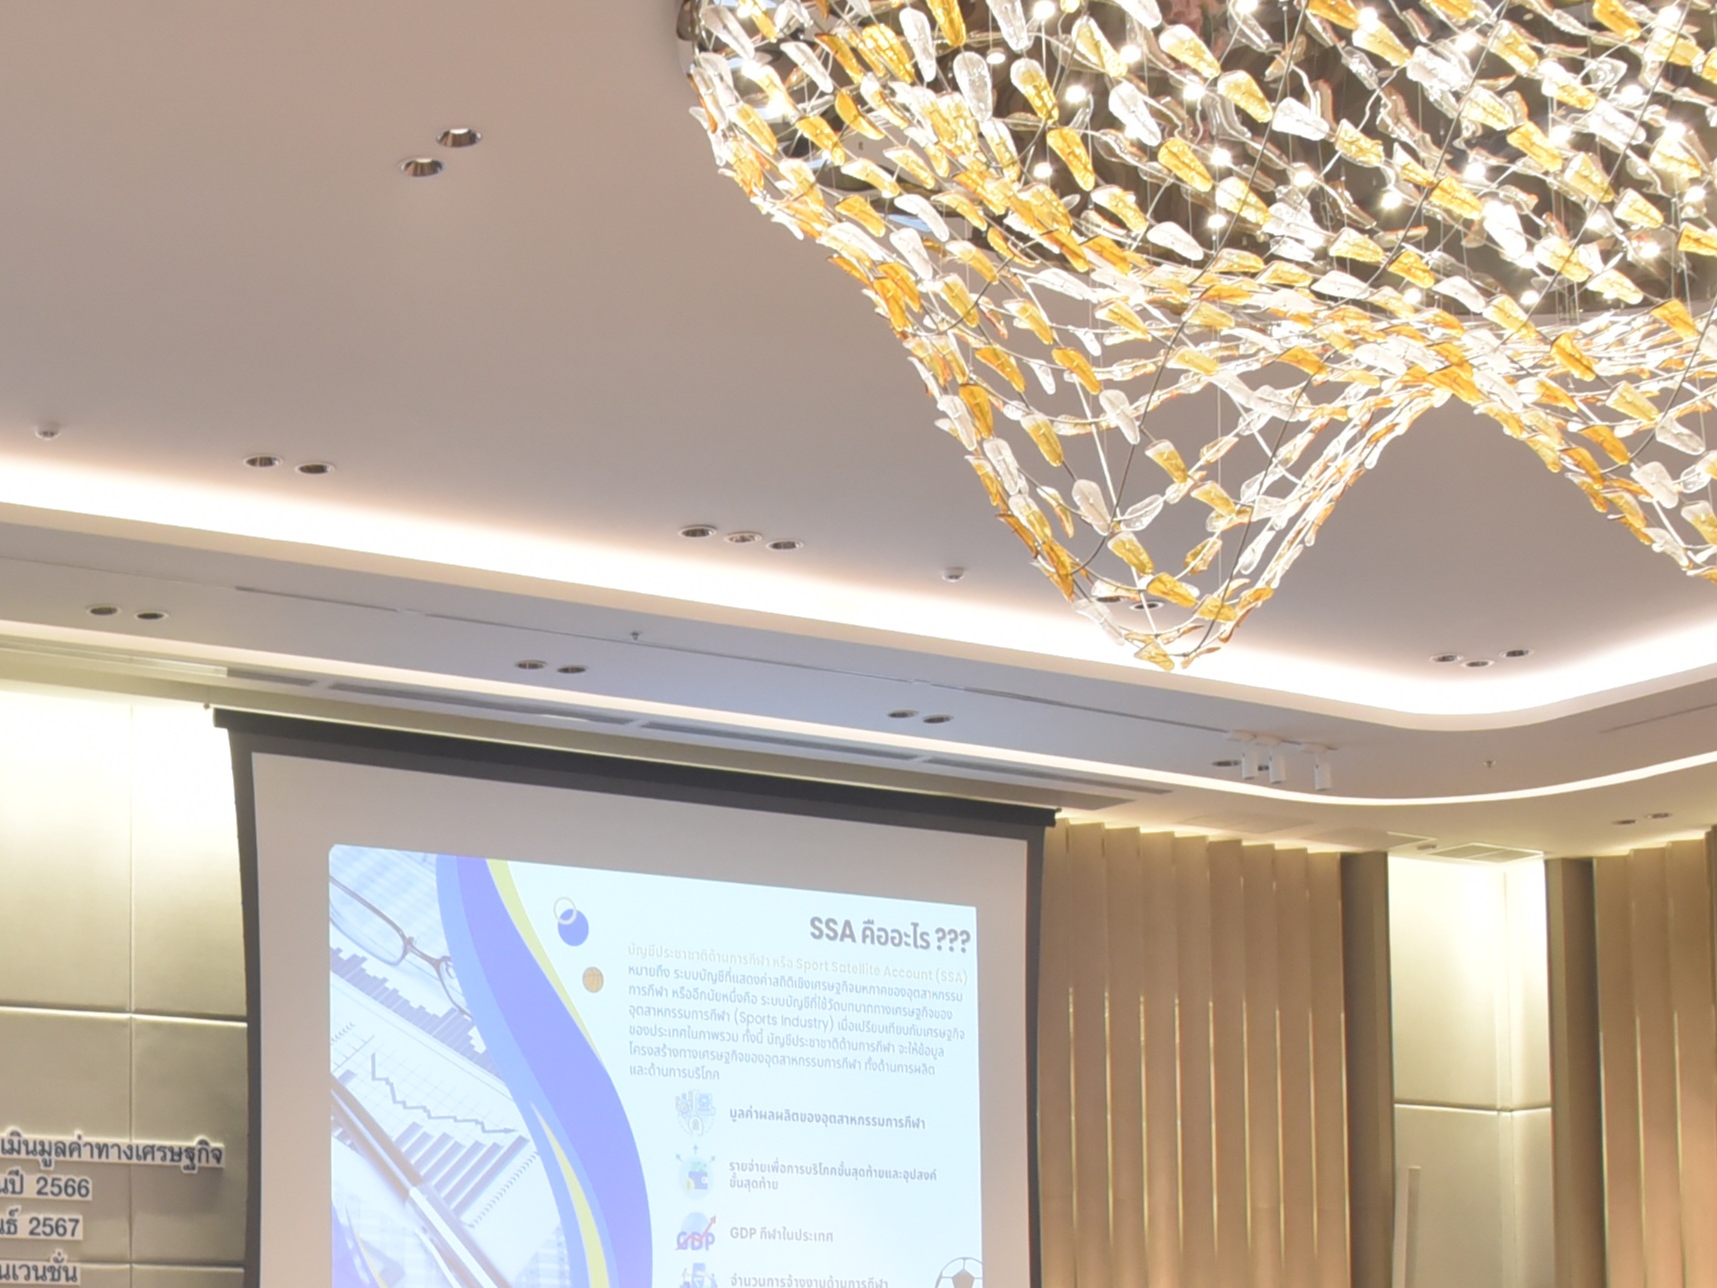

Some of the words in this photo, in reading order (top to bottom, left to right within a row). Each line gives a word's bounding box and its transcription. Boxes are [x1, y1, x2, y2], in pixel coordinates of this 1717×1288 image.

[809, 916, 857, 944] SSA
[861, 918, 931, 950] คืออะไร
[934, 927, 971, 954] ???
[796, 958, 829, 974] Sport
[832, 961, 881, 976] Satellite
[884, 966, 933, 982] Account
[935, 968, 968, 986] (SSA)
[628, 983, 669, 998] การกีฬา
[628, 1004, 730, 1023] อุตสาหกรรมการกีฬา
[734, 1008, 778, 1028] (Sports
[781, 1013, 834, 1033] Industry)
[35, 1176, 91, 1198] 2566
[28, 1216, 80, 1238] 2567
[730, 1226, 757, 1240] GDP
[759, 1226, 834, 1243] กีฬาในประเทศ
[676, 1231, 716, 1251] GDP
